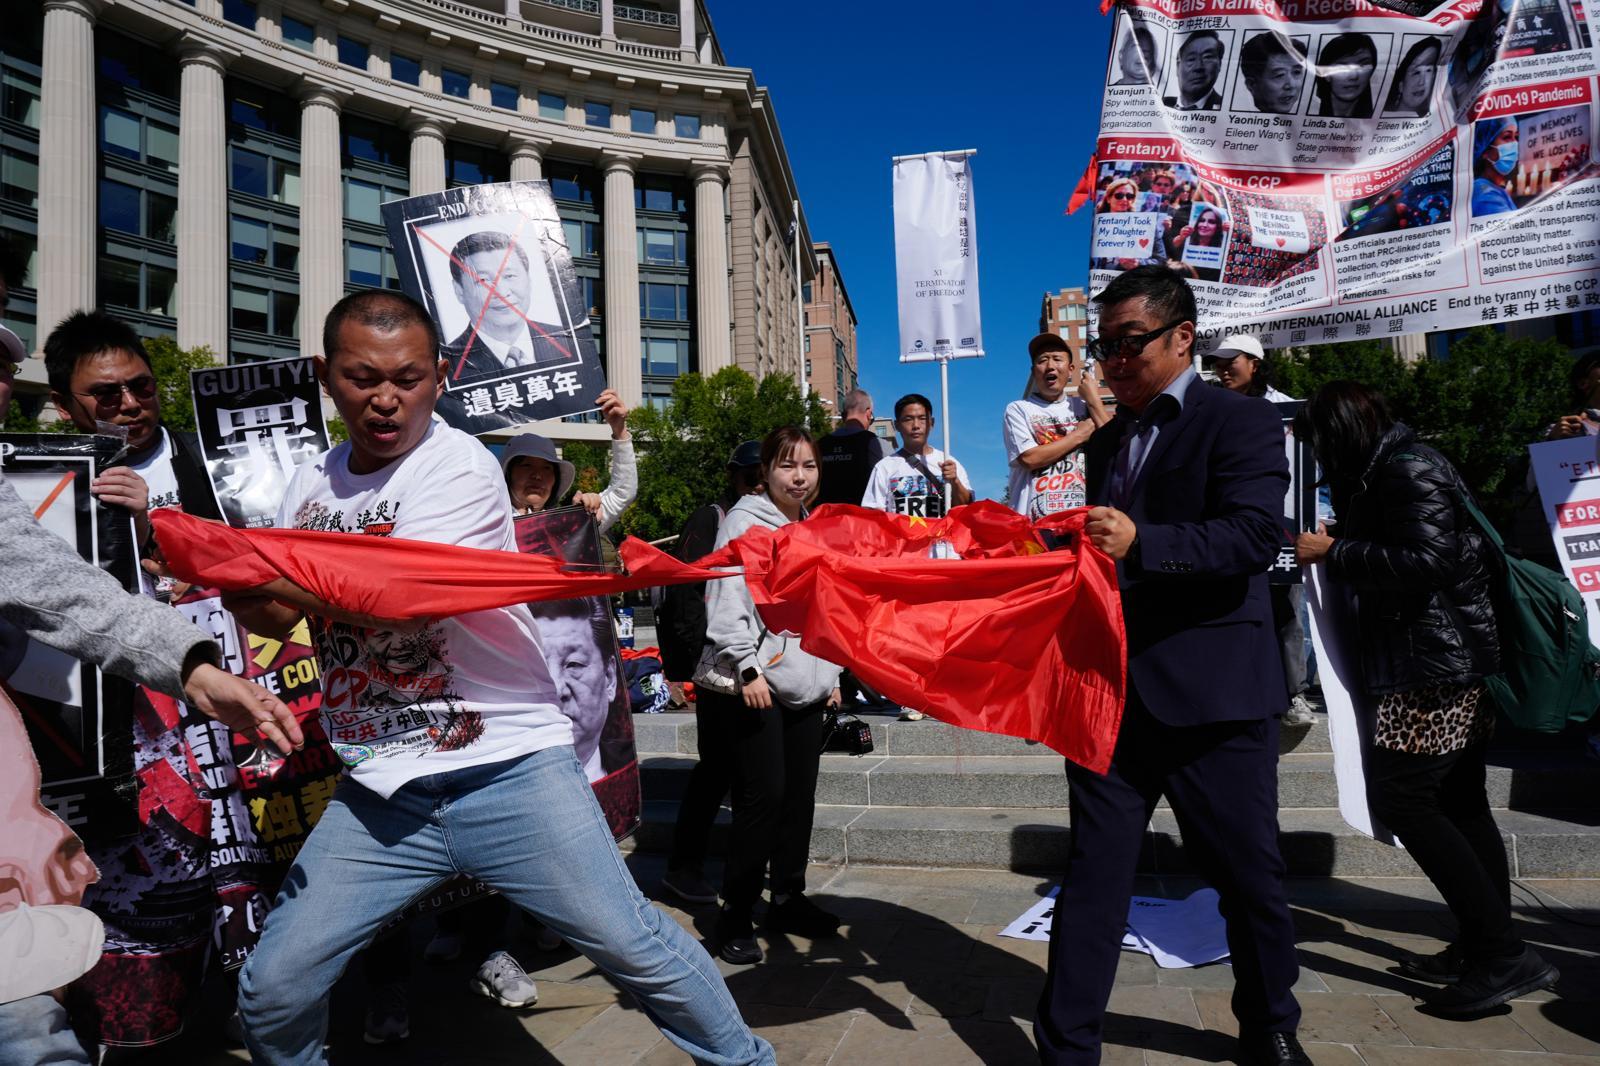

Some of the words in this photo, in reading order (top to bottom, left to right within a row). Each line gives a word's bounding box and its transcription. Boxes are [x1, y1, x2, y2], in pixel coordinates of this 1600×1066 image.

[1281, 1, 1297, 16] in
[1167, 20, 1184, 30] CCP
[1186, 17, 1230, 29] 中共代理人
[1508, 30, 1542, 41] SSOCIATION
[1507, 61, 1520, 70] York
[1521, 58, 1538, 67] linked
[1547, 54, 1564, 66] public
[1566, 51, 1592, 63] reporting
[1510, 71, 1532, 82] Chinese
[1534, 69, 1558, 79] overseas
[1559, 65, 1576, 77] police
[1107, 88, 1145, 97] Yuanjun
[1474, 92, 1529, 113] COVID-19
[1531, 85, 1583, 105] Pandemic
[1105, 99, 1121, 108] Spy
[1123, 98, 1147, 106] within
[1101, 121, 1152, 130] organization
[1187, 114, 1216, 124] Wang
[1228, 114, 1270, 128] Yaoning
[1273, 117, 1292, 127] Sun
[1302, 119, 1326, 128] Linda
[1328, 121, 1344, 129] Sun
[1376, 121, 1399, 131] Eileen
[1528, 126, 1536, 135] IN
[1541, 113, 1577, 130] MEMORY
[1225, 128, 1255, 138] Eileen
[1258, 129, 1292, 142] Wang's
[1299, 131, 1328, 140] Former
[1330, 132, 1346, 141] New
[1371, 134, 1400, 143] Former
[1527, 138, 1539, 148] OF
[1541, 134, 1556, 144] THE
[1560, 126, 1583, 141] LIVES
[1106, 141, 1176, 159] Fentanyl
[1223, 141, 1259, 151] Partner
[1296, 143, 1316, 152] State
[1318, 145, 1362, 155] government
[1533, 150, 1545, 159] WE
[1549, 144, 1568, 156] LOST
[1292, 154, 1318, 163] official
[1335, 174, 1371, 185] Digital
[1374, 138, 1443, 180] Surveillance
[1432, 162, 1451, 172] THAN
[1247, 175, 1281, 189] CCP
[1365, 167, 1412, 193] Security
[1411, 176, 1428, 186] YOU
[1430, 173, 1451, 183] THINK
[438, 202, 466, 219] END
[1556, 201, 1564, 210] of
[1097, 216, 1131, 226] Fentanyl
[1134, 216, 1151, 225] Took
[1255, 211, 1269, 219] THE
[1271, 212, 1296, 223] FACES
[1098, 227, 1109, 237] My
[1112, 227, 1146, 237] Daughter
[1254, 226, 1268, 236] THE
[1269, 228, 1306, 239] NUMBERS
[1262, 221, 1290, 230] BEHIND
[1470, 224, 1484, 233] The
[1097, 239, 1124, 248] Forever
[1127, 239, 1135, 248] 19
[1388, 235, 1402, 245] and
[1405, 228, 1451, 241] researchers
[1480, 233, 1541, 248] accountability
[1335, 254, 1358, 263] warn
[1360, 249, 1375, 259] that
[1377, 245, 1420, 257] PRC-linked
[1422, 239, 1441, 249] data
[1481, 252, 1498, 262] The
[1500, 248, 1520, 259] CCP
[1522, 243, 1563, 256] launched
[1575, 239, 1596, 249] virus
[1337, 262, 1379, 274] collection,
[1380, 256, 1402, 268] cyber
[1482, 264, 1516, 277] against
[1518, 260, 1533, 270] the
[1535, 256, 1564, 268] United
[1337, 275, 1362, 285] online
[1402, 271, 1422, 281] risks
[1424, 269, 1436, 278] for
[914, 279, 966, 289] TERMINATOR
[1207, 285, 1220, 295] the
[1222, 287, 1238, 297] CCP
[1284, 275, 1316, 288] deaths
[916, 290, 927, 298] OF
[929, 288, 966, 298] FREEDOM
[1207, 299, 1224, 309] year.
[1274, 292, 1294, 302] total
[1297, 287, 1306, 296] of
[1343, 288, 1390, 300] Americans.
[1448, 296, 1471, 309] End
[1474, 294, 1491, 305] the
[1495, 290, 1536, 305] tyranny
[1540, 285, 1551, 296] of
[1554, 283, 1571, 293] the
[1574, 278, 1598, 291] CCP
[1197, 308, 1208, 316] CP
[1481, 293, 1600, 321] 結束中共暴政
[1224, 323, 1265, 337] PARTY
[1269, 311, 1371, 331] INTERNATIONAL
[1373, 299, 1437, 319] ALLIANCE
[198, 358, 314, 397] GUILTY!
[462, 370, 583, 418] 遺臭萬年
[1035, 473, 1076, 493] CCP
[1564, 506, 1600, 523] FOR
[1567, 540, 1600, 554] TRA
[417, 881, 487, 913] FUTUR
